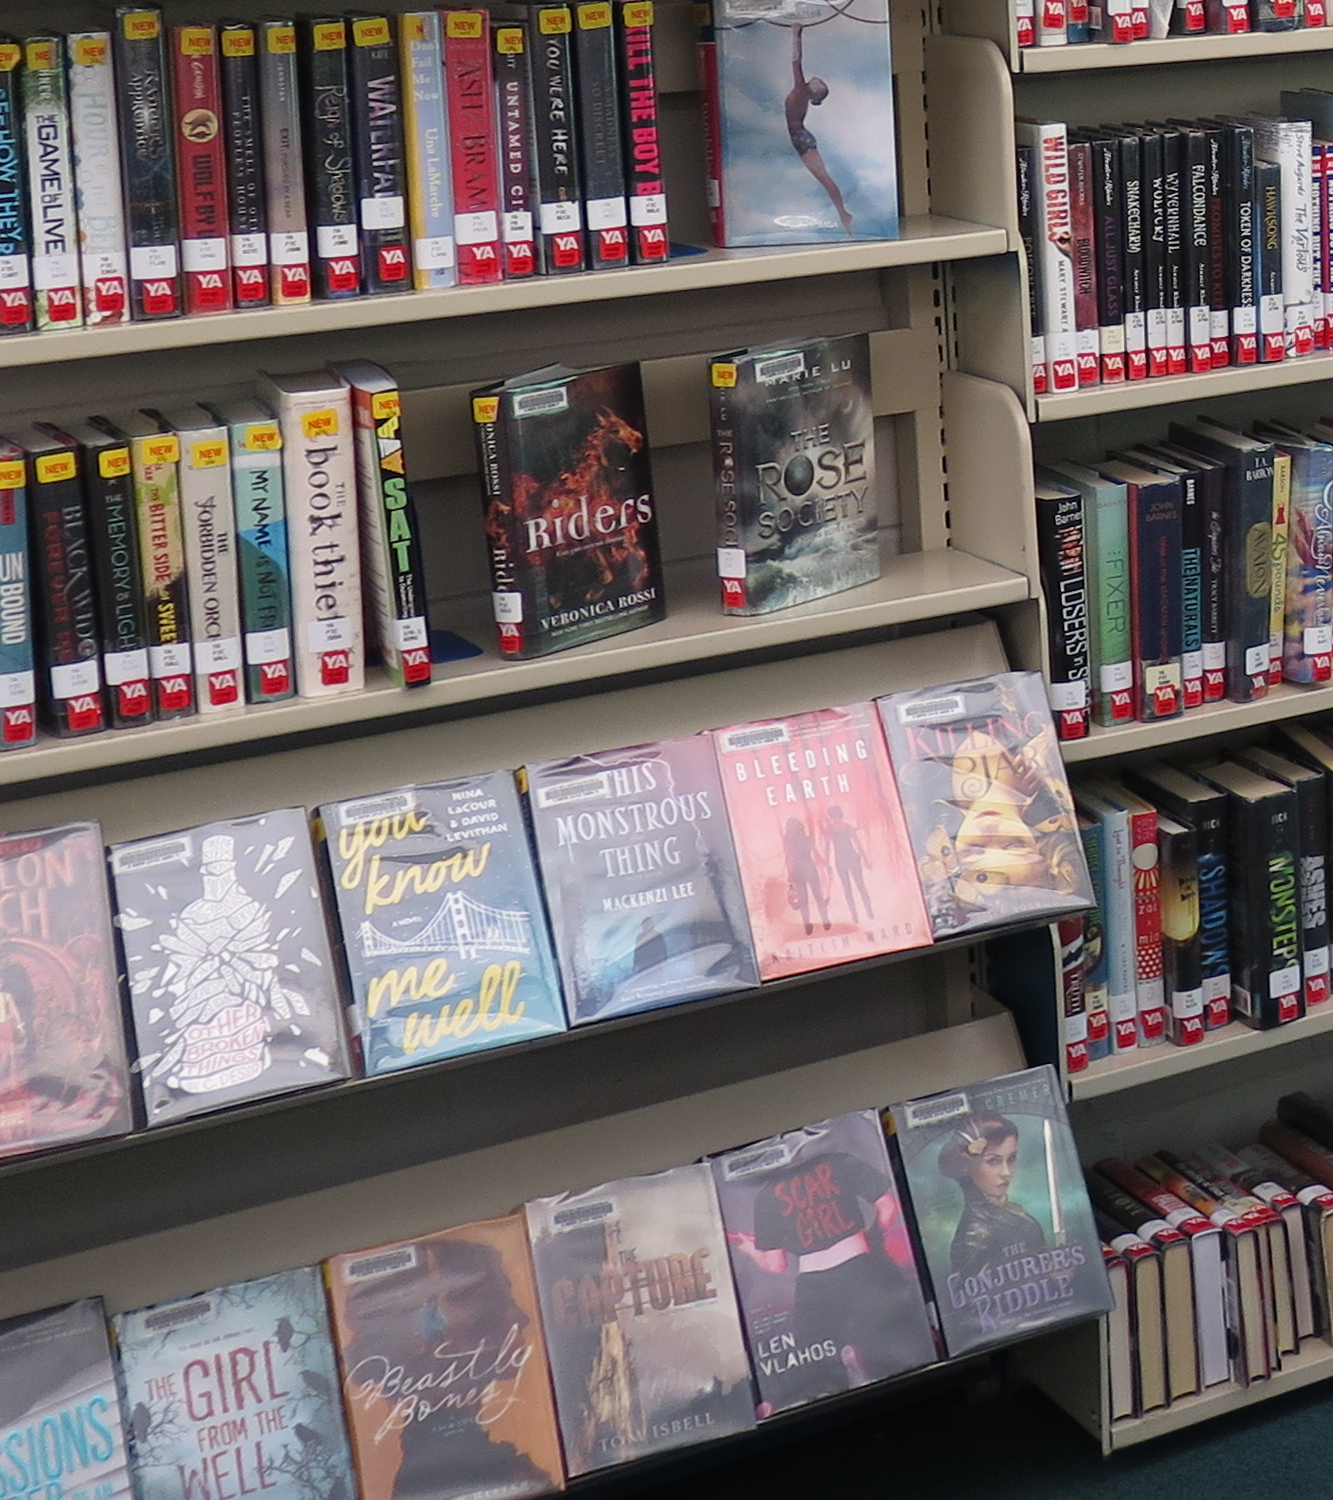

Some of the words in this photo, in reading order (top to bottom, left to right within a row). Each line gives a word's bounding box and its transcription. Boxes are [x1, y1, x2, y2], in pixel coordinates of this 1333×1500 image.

[132, 18, 156, 31] NEW
[545, 39, 561, 71] YOU
[549, 75, 564, 123] WERE
[627, 74, 656, 123] THE
[551, 128, 568, 176] HERE
[630, 129, 659, 175] BOY
[1192, 163, 1207, 247] FALCONDANCE
[145, 282, 171, 297] YA
[831, 359, 851, 372] LU
[790, 423, 831, 452] THE
[307, 443, 338, 537] book
[754, 441, 867, 506] ROSE
[385, 478, 410, 573] SAT
[524, 491, 654, 554] Riders
[758, 488, 869, 539] SOCIETY
[539, 595, 614, 632] VERONICA
[615, 586, 658, 612] ROSSI
[1104, 558, 1126, 634] FIXER
[602, 762, 657, 799] THIS
[736, 739, 870, 783] BLEEDING
[451, 788, 484, 801] NINA
[766, 772, 852, 808] EARTH
[445, 823, 508, 843] LEVITHAN
[461, 813, 499, 828] DAVID
[557, 791, 712, 846] MONSTROUS
[339, 810, 429, 890] you
[600, 836, 682, 879] THING
[363, 842, 490, 915] know
[602, 886, 669, 913] MACKENZI
[671, 881, 695, 899] LEE
[366, 959, 456, 1017] me
[403, 963, 528, 1054] well
[186, 1025, 266, 1062] BROKEN
[188, 1002, 260, 1040] OTHER
[184, 1046, 261, 1078] THINGS
[773, 1162, 842, 1217] SCAR
[795, 1206, 854, 1250] GIRL
[1003, 1243, 1027, 1259] THE
[550, 1247, 718, 1327] CAPTURE
[947, 1246, 1086, 1310] CONJURER'S
[973, 1273, 1075, 1335] RIDDLE
[347, 1322, 533, 1412] Beastly
[757, 1332, 796, 1359] LEN
[758, 1340, 837, 1377] VLAHOS
[144, 1372, 179, 1403] THE
[183, 1340, 291, 1422] GIRL
[196, 1418, 249, 1453] FROM
[253, 1405, 289, 1435] THE
[374, 1380, 505, 1445] Bones
[655, 1411, 717, 1439] ISBELL
[177, 1441, 280, 1500] WELL
